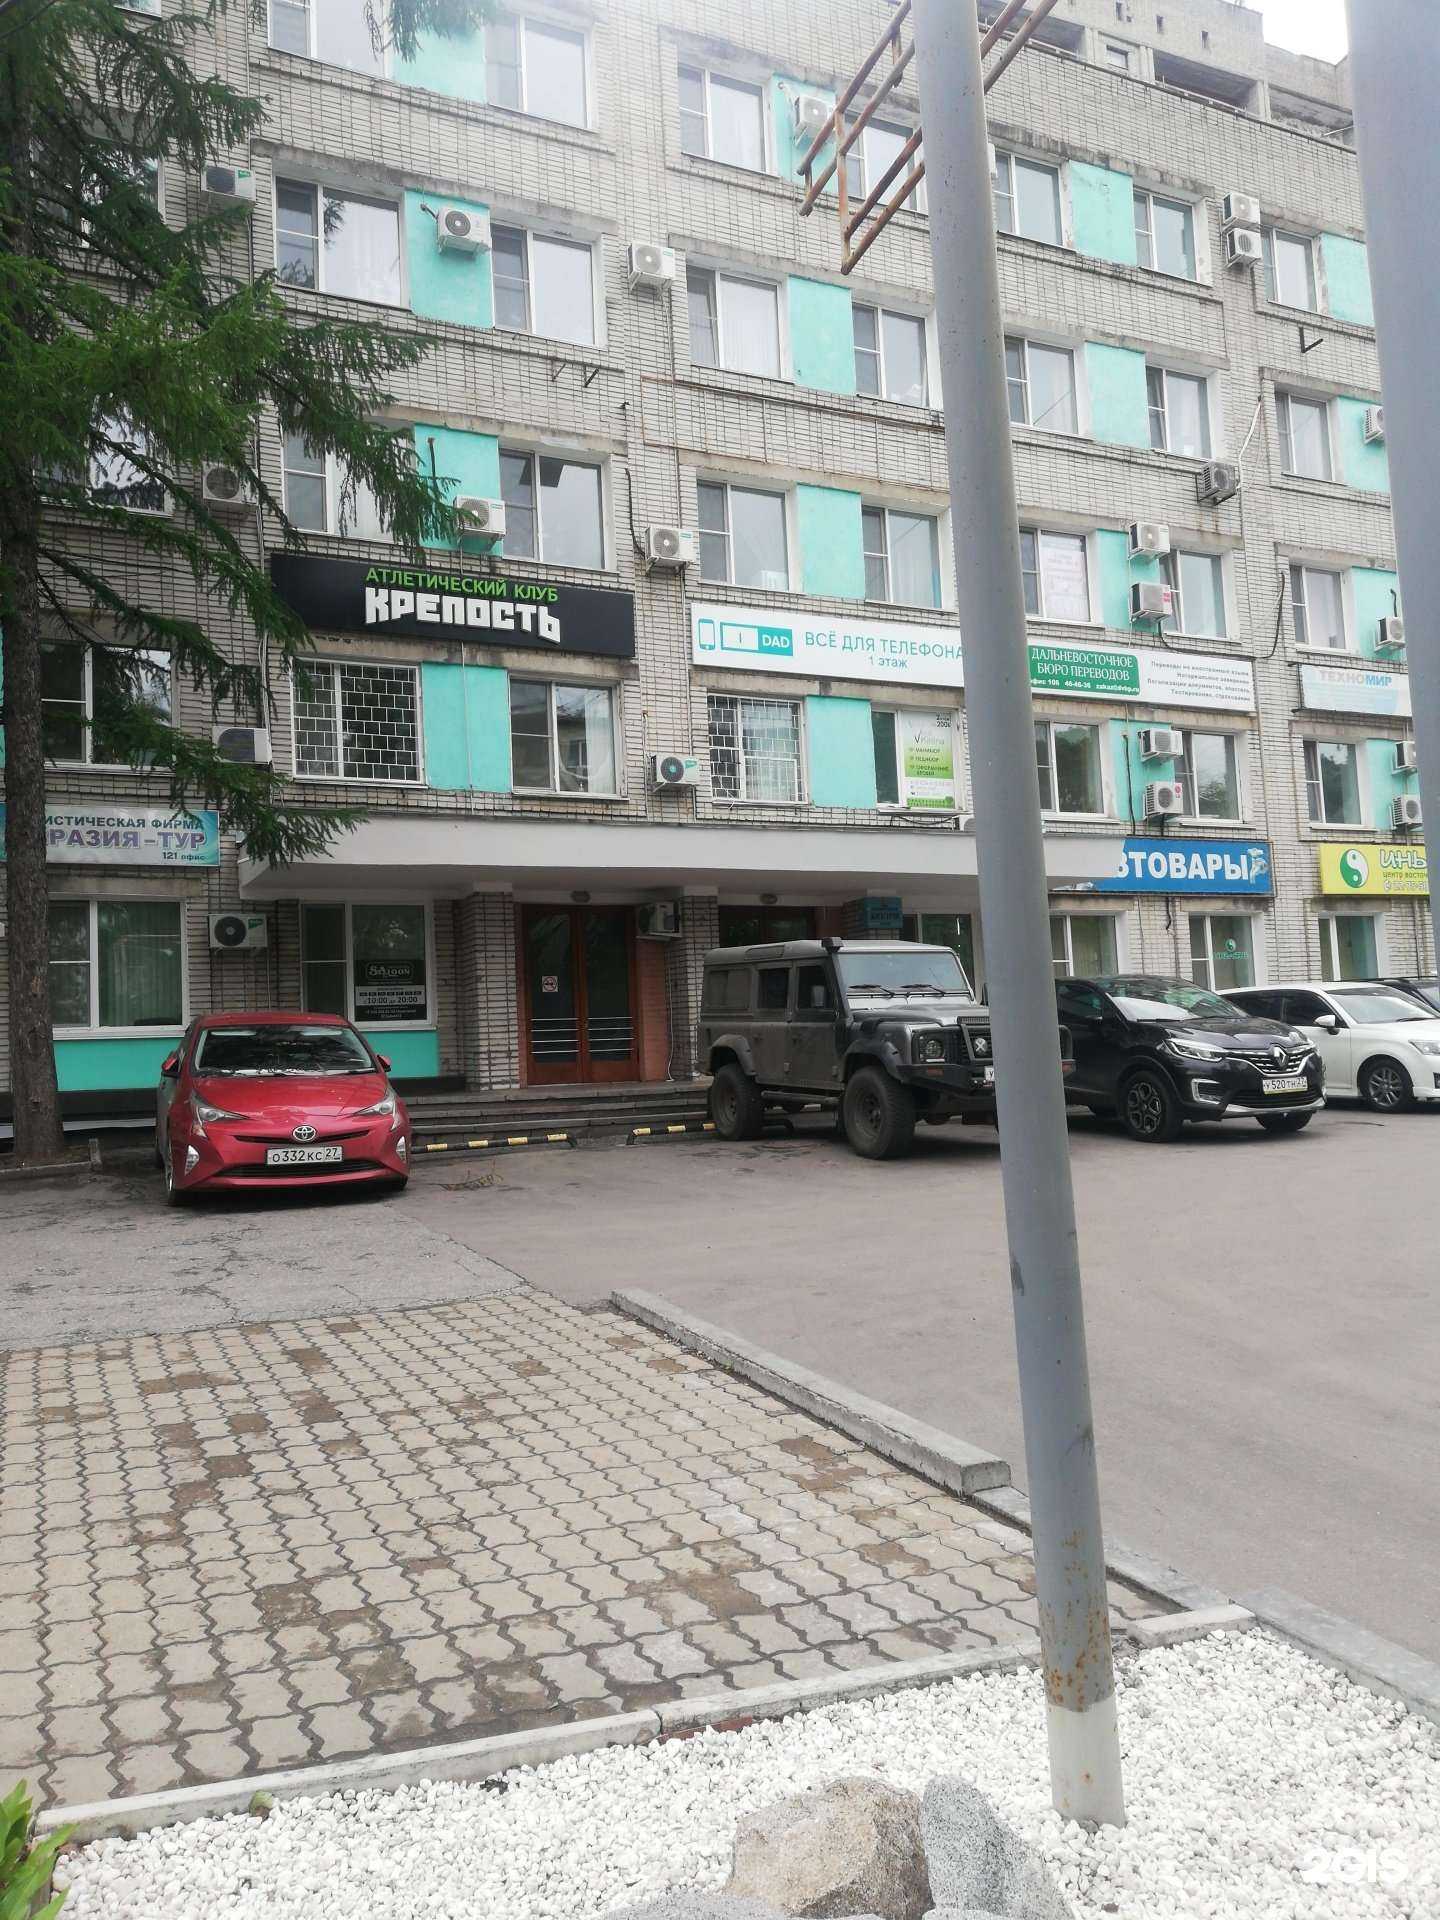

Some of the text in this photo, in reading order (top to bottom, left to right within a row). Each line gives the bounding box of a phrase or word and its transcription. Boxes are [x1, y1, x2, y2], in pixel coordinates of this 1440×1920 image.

[365, 567, 559, 602] АТЛЕТИЧЕСКИЙ КЛУБ
[364, 587, 562, 644] КРЕПОСТЬ
[762, 634, 790, 648] DAD
[805, 630, 837, 648] ВСЁ
[842, 635, 875, 653] ДЛЯ
[869, 656, 908, 669] 1 этаж
[1031, 648, 1134, 668] ДАЛЬНЕВОСТОЧНОЕ
[1037, 663, 1130, 681] БЮРО ПЕРЕВОДОВ
[1319, 670, 1392, 687] ТЕХНОМИР
[45, 815, 204, 830] ИСТИЧЕСКАЯ ФИРМА
[162, 852, 178, 860] 121
